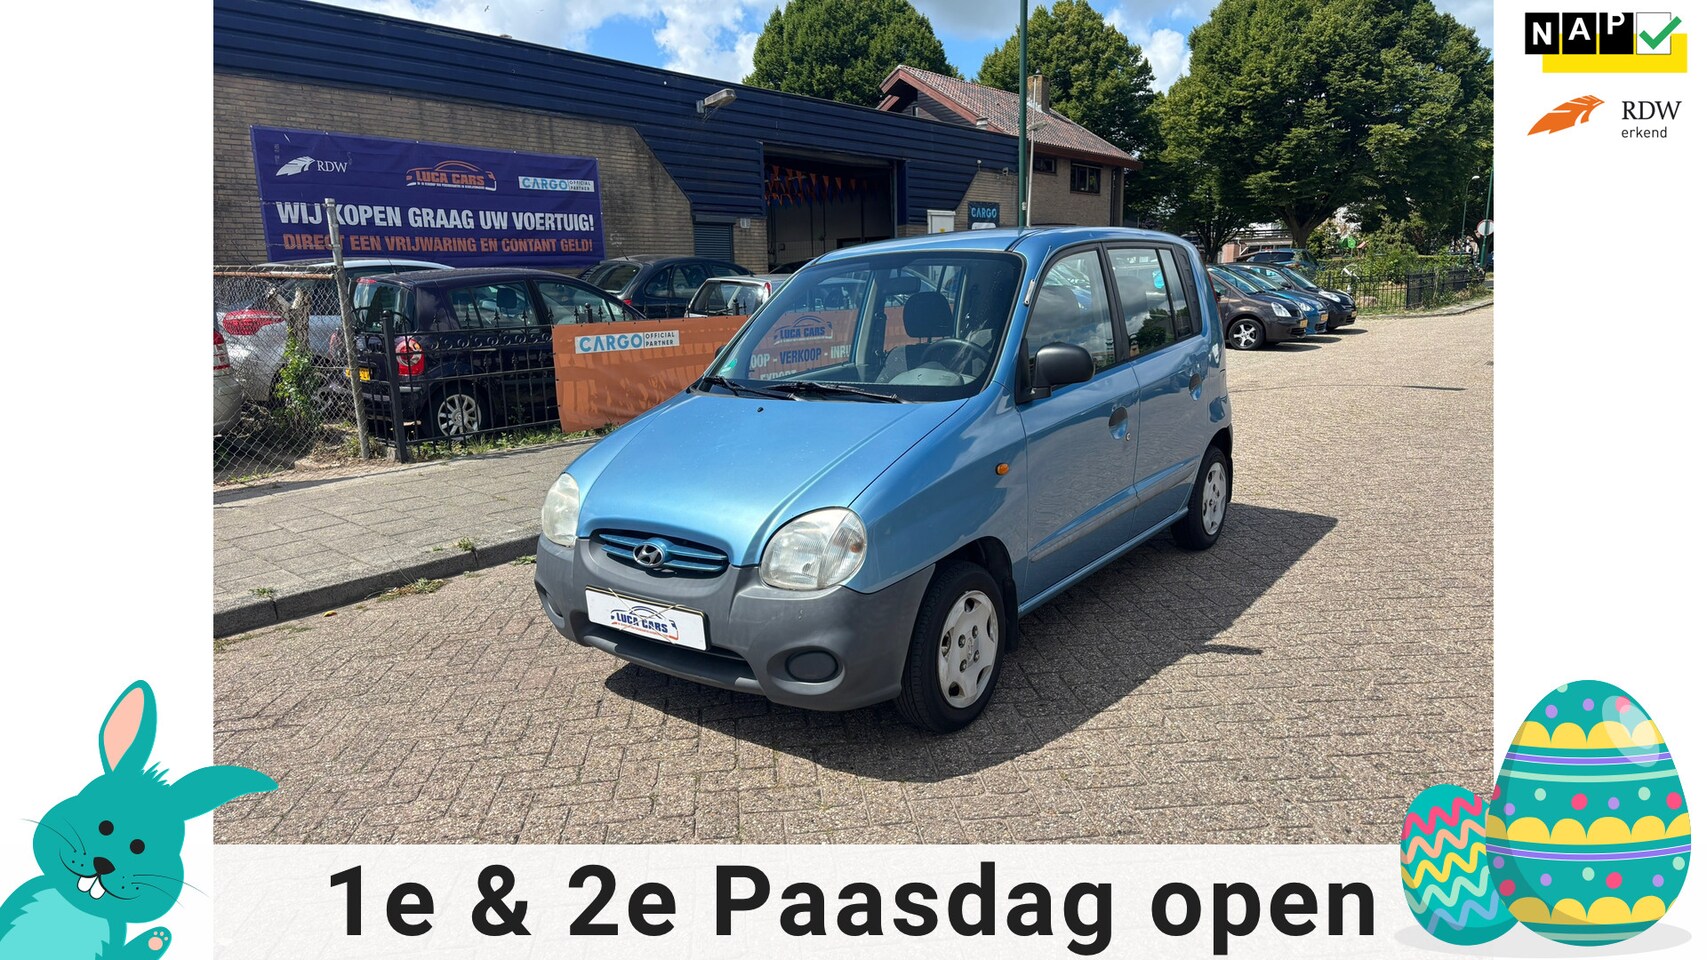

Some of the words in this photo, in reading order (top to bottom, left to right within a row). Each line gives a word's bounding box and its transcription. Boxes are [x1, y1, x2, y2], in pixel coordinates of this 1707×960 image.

[316, 159, 348, 173] RDW
[415, 170, 448, 183] LUCA
[451, 173, 485, 186] CARS
[522, 177, 568, 190] CARGO
[276, 201, 323, 225] WIJ
[408, 207, 475, 230] GRAAG
[479, 210, 508, 231] UW
[512, 211, 595, 232] VOERTUIG!
[971, 207, 998, 219] CARGO
[350, 234, 383, 251] EEN
[385, 235, 477, 253] VRIJWARING
[480, 237, 499, 253] EN
[501, 238, 557, 253] CONTANT
[560, 239, 593, 253] GELD!
[780, 328, 801, 340] LUCA
[803, 326, 826, 337] CARS
[579, 333, 643, 353] CARGO
[645, 339, 674, 347] PARTNER
[749, 353, 770, 369] OOP
[780, 347, 822, 365] VERKOOP
[616, 612, 639, 626] LUCA
[642, 618, 668, 634] CARS
